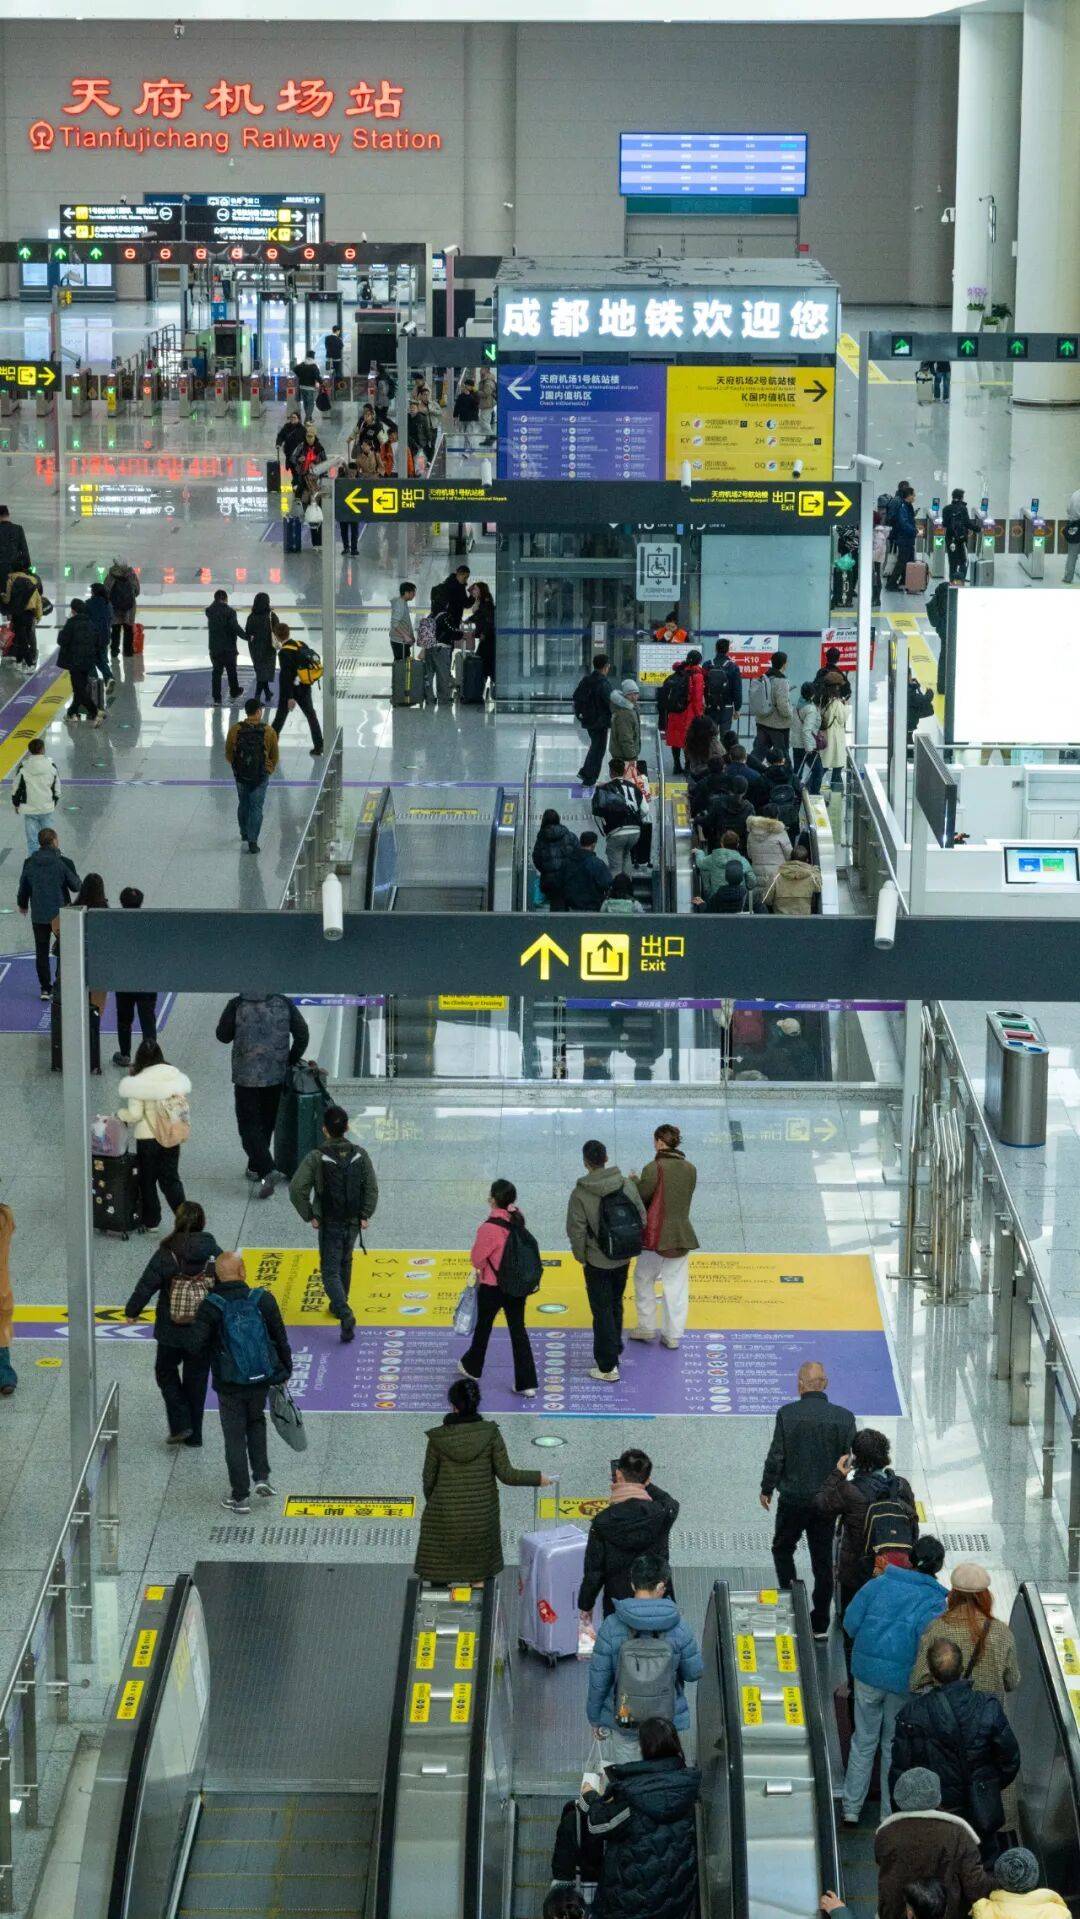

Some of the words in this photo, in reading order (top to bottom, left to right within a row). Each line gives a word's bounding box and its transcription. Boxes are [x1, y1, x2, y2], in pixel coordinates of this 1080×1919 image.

[62, 78, 404, 119] 天府机场站
[59, 126, 230, 154] Tianfujichang
[243, 127, 341, 155] Railway
[353, 127, 441, 150] Station
[268, 228, 278, 240] K
[503, 298, 829, 339] 成都地铁欢迎您
[540, 374, 619, 384] 天府机场1号航站楼
[716, 376, 796, 385] 天府机场2号航站楼
[540, 391, 592, 400] J国内值机区
[401, 488, 424, 500] 出口
[772, 490, 795, 503] 出口
[781, 503, 794, 511] Exit
[641, 934, 685, 957] 出口
[641, 959, 667, 972] Exit
[294, 1508, 404, 1517] 注意脚下
